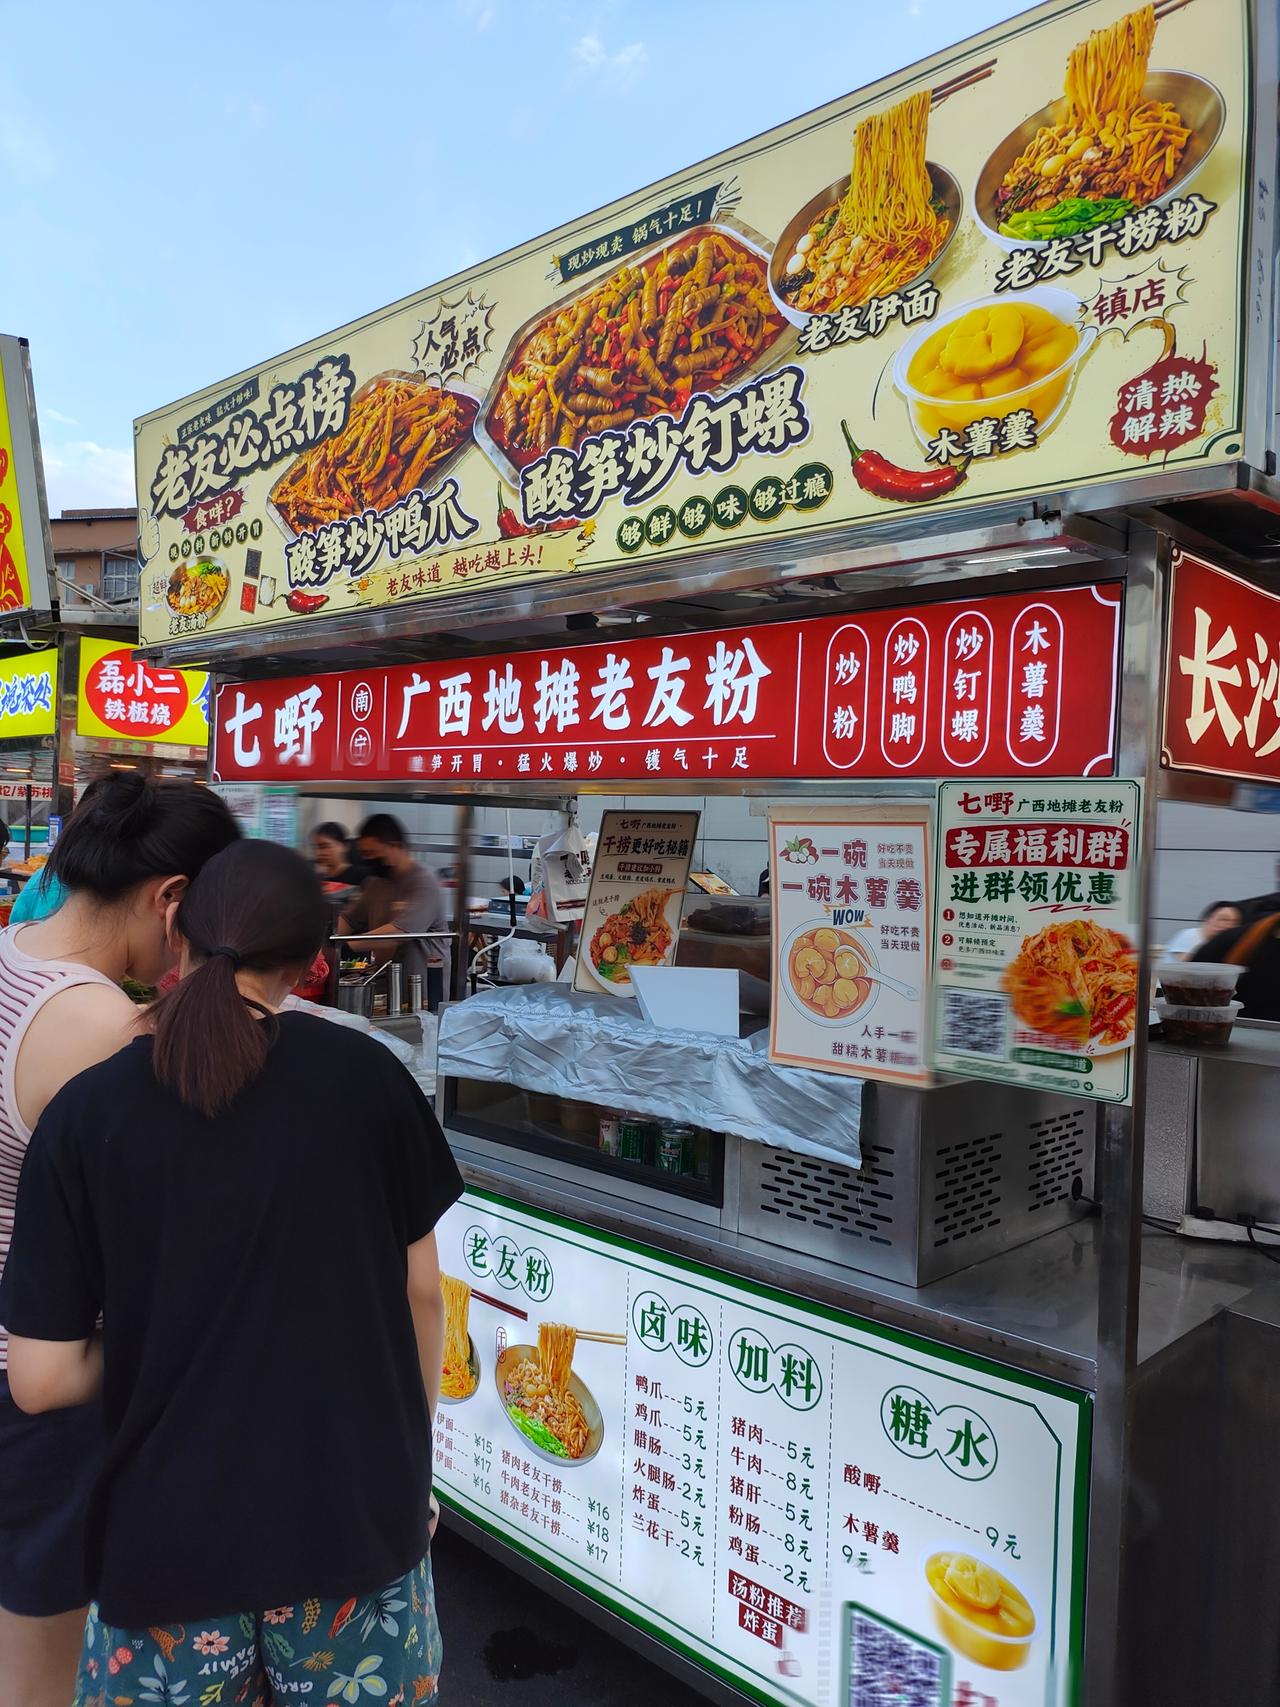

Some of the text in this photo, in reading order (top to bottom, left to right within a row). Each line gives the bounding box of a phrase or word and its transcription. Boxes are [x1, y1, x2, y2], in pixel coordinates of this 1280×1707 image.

[567, 236, 623, 271] 现炒现卖
[995, 195, 1217, 291] 老友干捞粉
[797, 281, 940, 355] 老友伊面
[1095, 279, 1167, 326] 镇店
[1123, 371, 1202, 411] 清热
[151, 358, 354, 514] 老友必点榜
[523, 368, 806, 520] 酸笋炒钉螺
[926, 410, 1038, 464] 木薯羹
[1121, 408, 1198, 446] 解辣
[287, 482, 476, 587] 酸笋炒鸭爪
[387, 543, 543, 597] 老友味道 越吃越上头!
[95, 660, 181, 696] 磊小二
[395, 636, 772, 740] 广西地摊老友粉
[832, 651, 861, 740] 炒粉
[888, 632, 920, 745] 炒鸭脚
[950, 626, 984, 743] 炒钉螺
[1019, 620, 1052, 743] 木薯羹
[104, 698, 171, 726] 铁板烧
[225, 683, 326, 767] 七嘢
[957, 792, 1124, 815] 七嘢 广西地摊老友粉
[602, 835, 689, 857] 干捞更好吃秘籍
[821, 839, 868, 869] 一碗
[949, 827, 1125, 868] 专属福利群
[781, 875, 923, 911] 一碗木薯羹
[950, 871, 1120, 905] 进群领优惠
[833, 908, 865, 926] WOW
[880, 925, 920, 937] 好吃不贵
[880, 940, 921, 951] 当天现做
[466, 1233, 550, 1294] 老友粉
[639, 1301, 708, 1359] 卤味
[735, 1336, 817, 1403] 加料
[635, 1374, 707, 1422] 鸭爪 5元
[474, 1433, 493, 1455] ¥15
[634, 1402, 707, 1450] 鸡爪 5元
[731, 1415, 815, 1470] 猪肉 5元
[889, 1394, 990, 1469] 糖水
[473, 1453, 492, 1474] ¥17
[633, 1428, 706, 1479] 腊肠 3元
[730, 1446, 814, 1501] 牛肉 8元
[473, 1473, 491, 1495] ¥16
[500, 1469, 609, 1543] 牛肉老友干捞 ¥18
[501, 1449, 610, 1521] 猪肉老友干捞 ¥16
[632, 1483, 705, 1537] 炸蛋 5元
[633, 1457, 706, 1509] 火腿肠 2元
[729, 1474, 813, 1532] 猪肝 5元
[500, 1489, 609, 1564] 猪杂老友干捞 ¥17
[728, 1503, 812, 1563] 粉肠 8元
[842, 1512, 900, 1555] 木薯羹
[843, 1463, 1021, 1560] 酸嘢 9元
[631, 1511, 705, 1567] 兰花干 2元
[728, 1535, 811, 1594] 鸡蛋 2元
[732, 1575, 804, 1628] 汤粉推荐
[743, 1608, 778, 1644] 炸蛋
